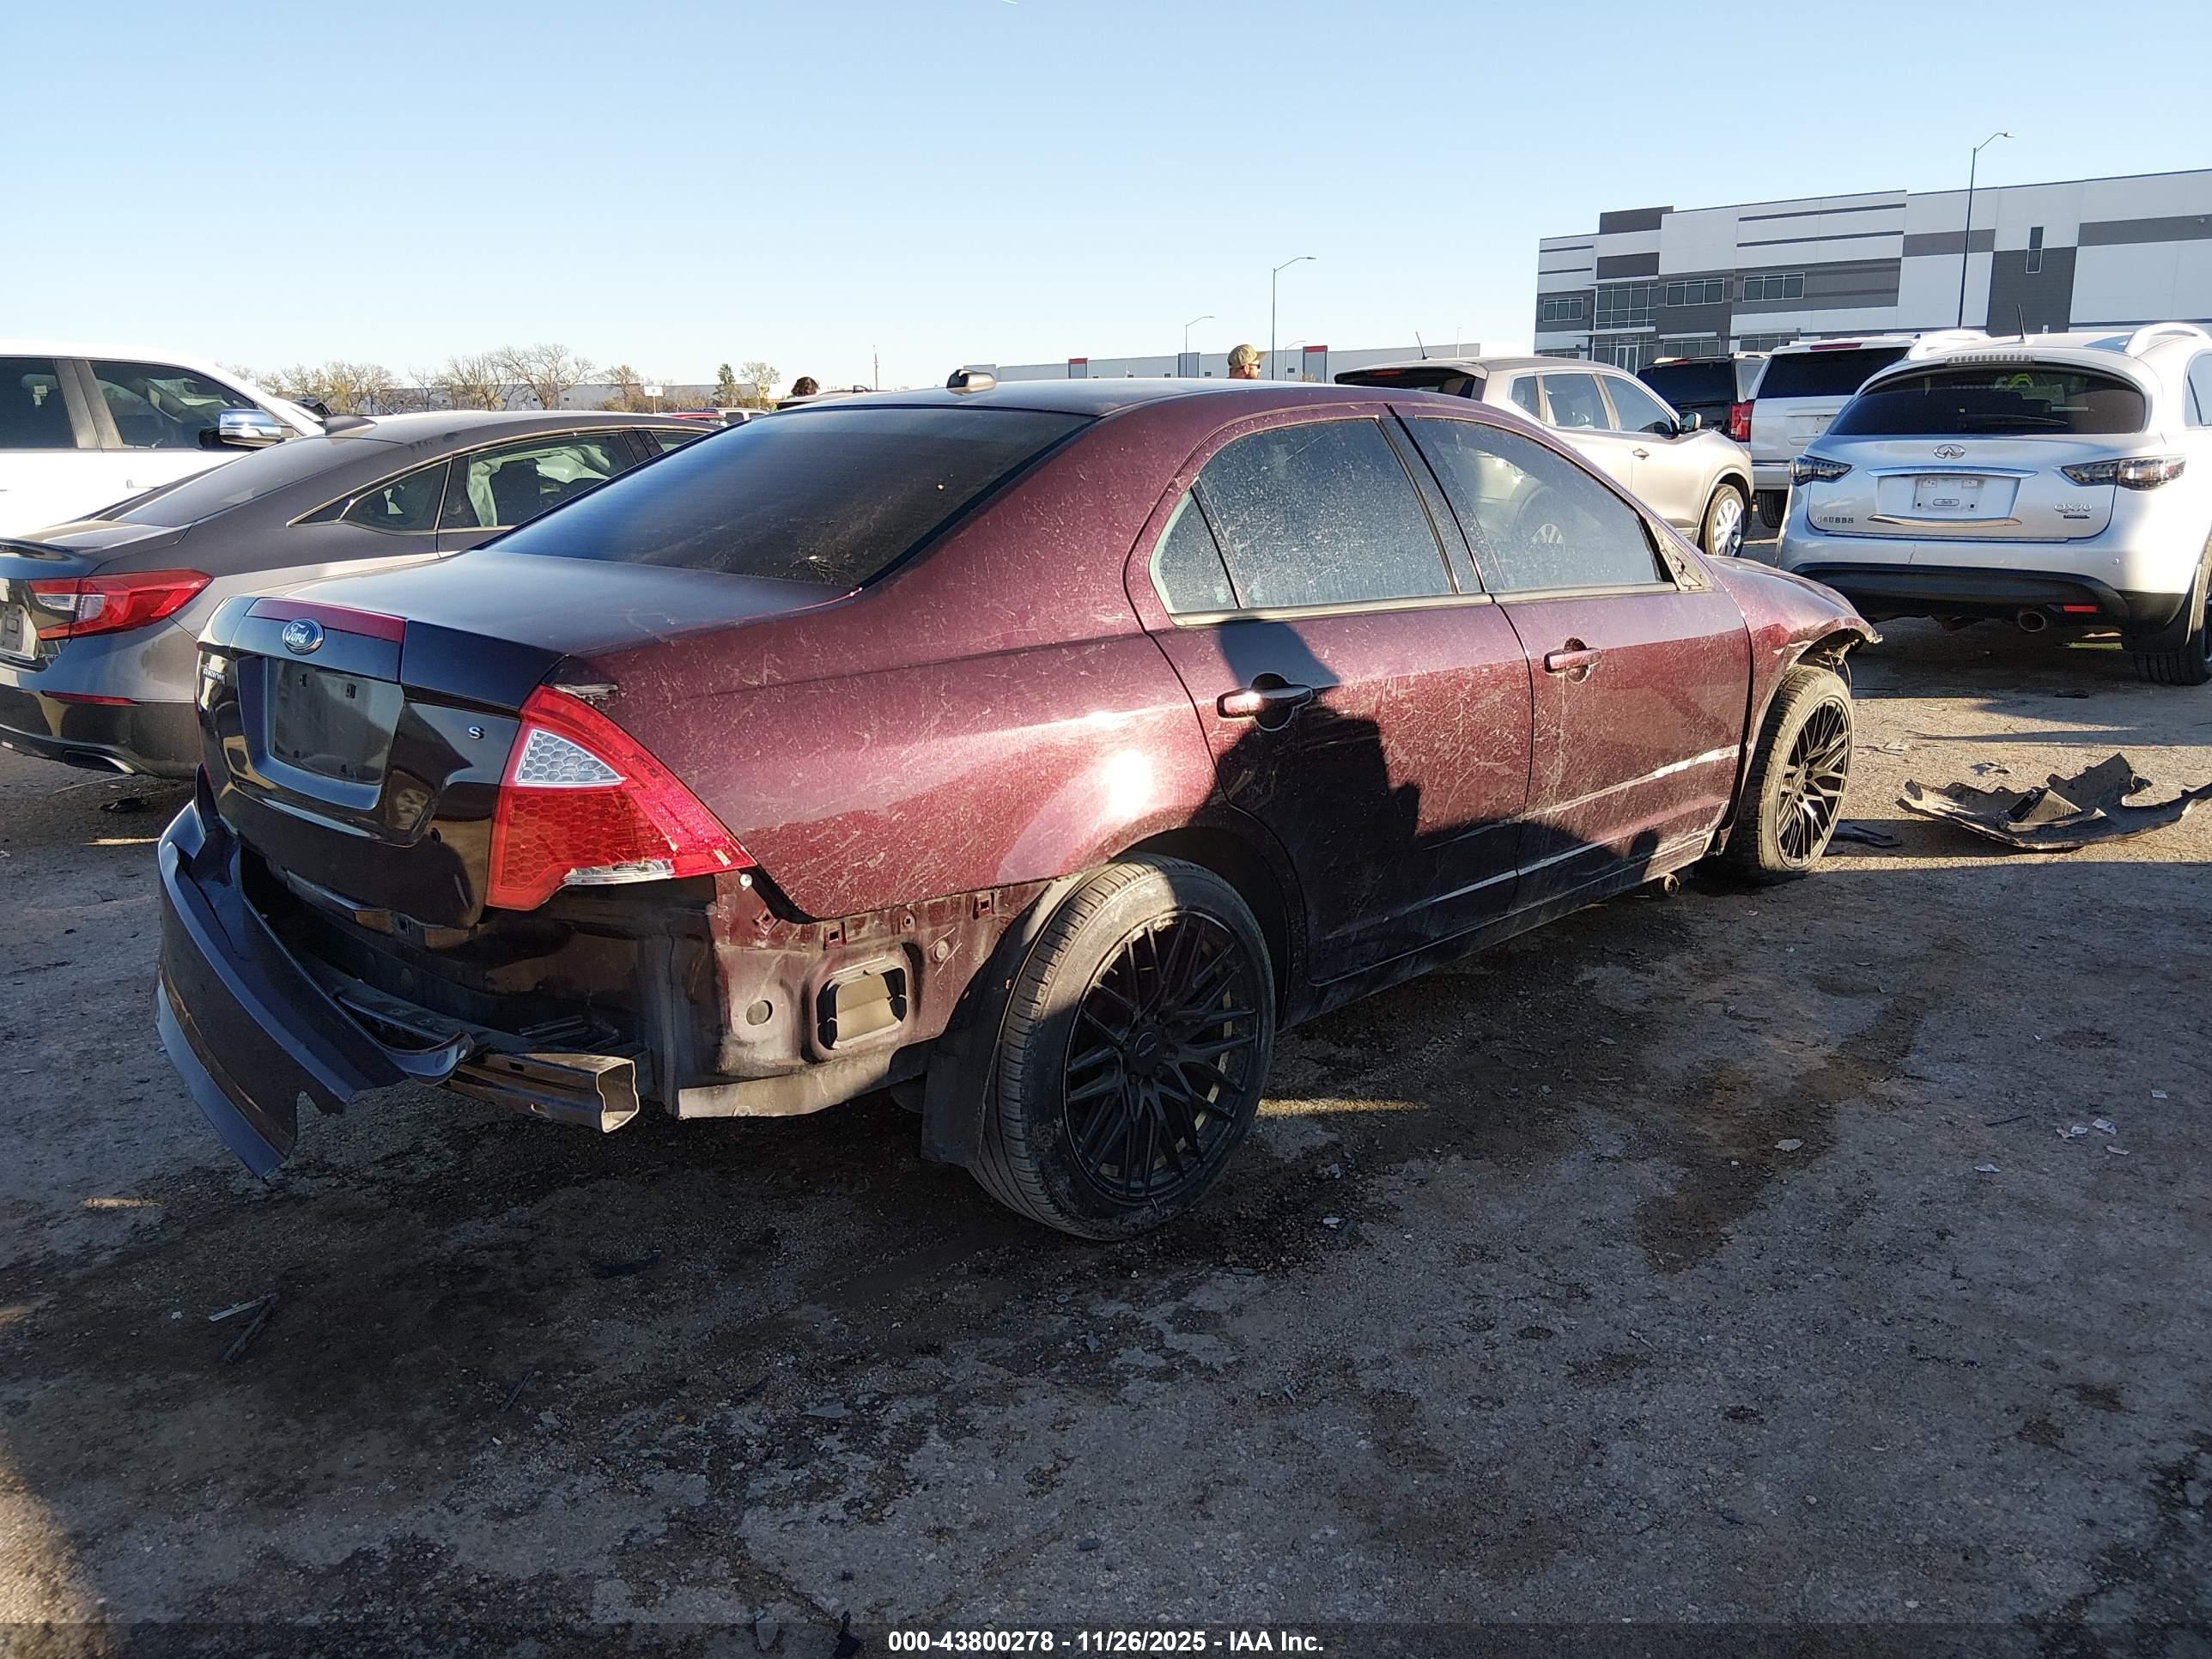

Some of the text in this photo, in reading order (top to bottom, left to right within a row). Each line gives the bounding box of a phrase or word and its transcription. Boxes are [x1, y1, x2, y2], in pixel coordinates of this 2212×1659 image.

[2054, 502, 2093, 514] QX70
[285, 623, 310, 644] Ford
[468, 726, 485, 739] S
